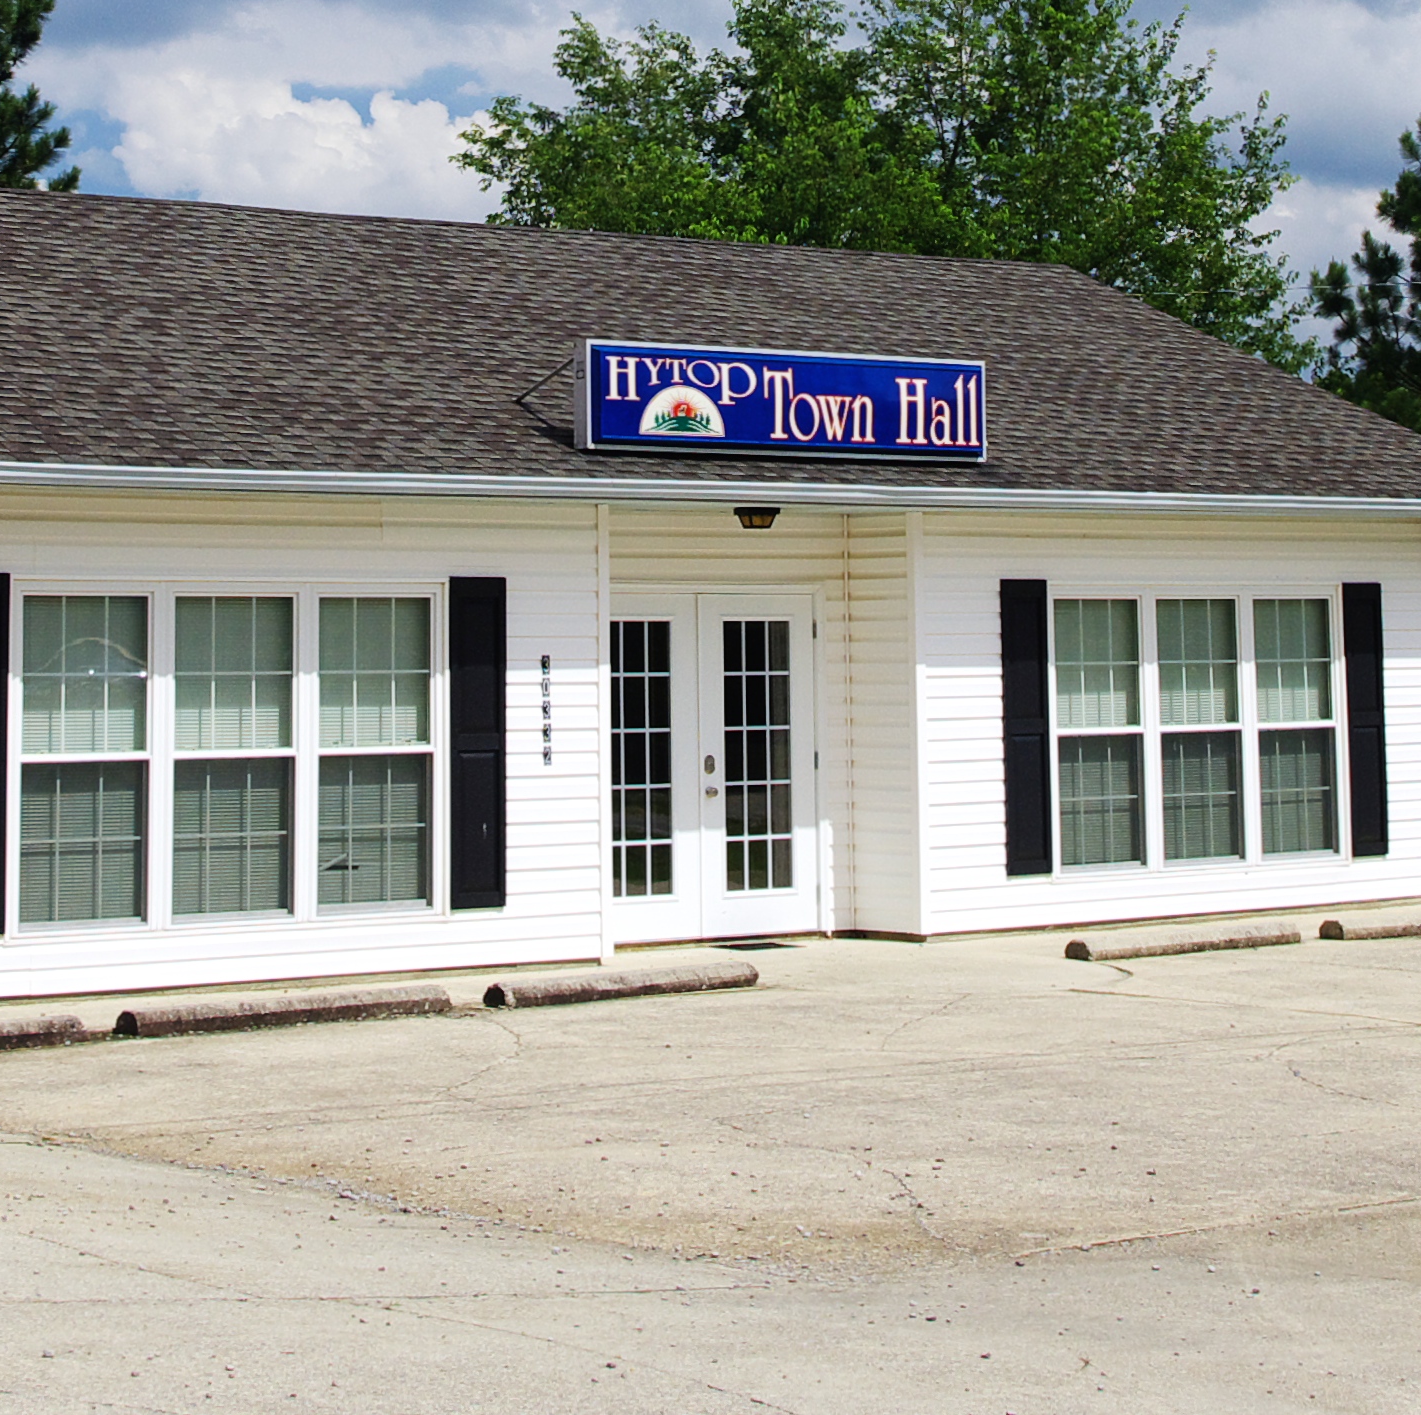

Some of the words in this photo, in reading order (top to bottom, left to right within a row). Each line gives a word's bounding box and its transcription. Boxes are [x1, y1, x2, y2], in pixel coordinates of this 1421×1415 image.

[605, 355, 757, 404] HYTOP
[763, 366, 875, 442] Town
[895, 374, 980, 446] Hall
